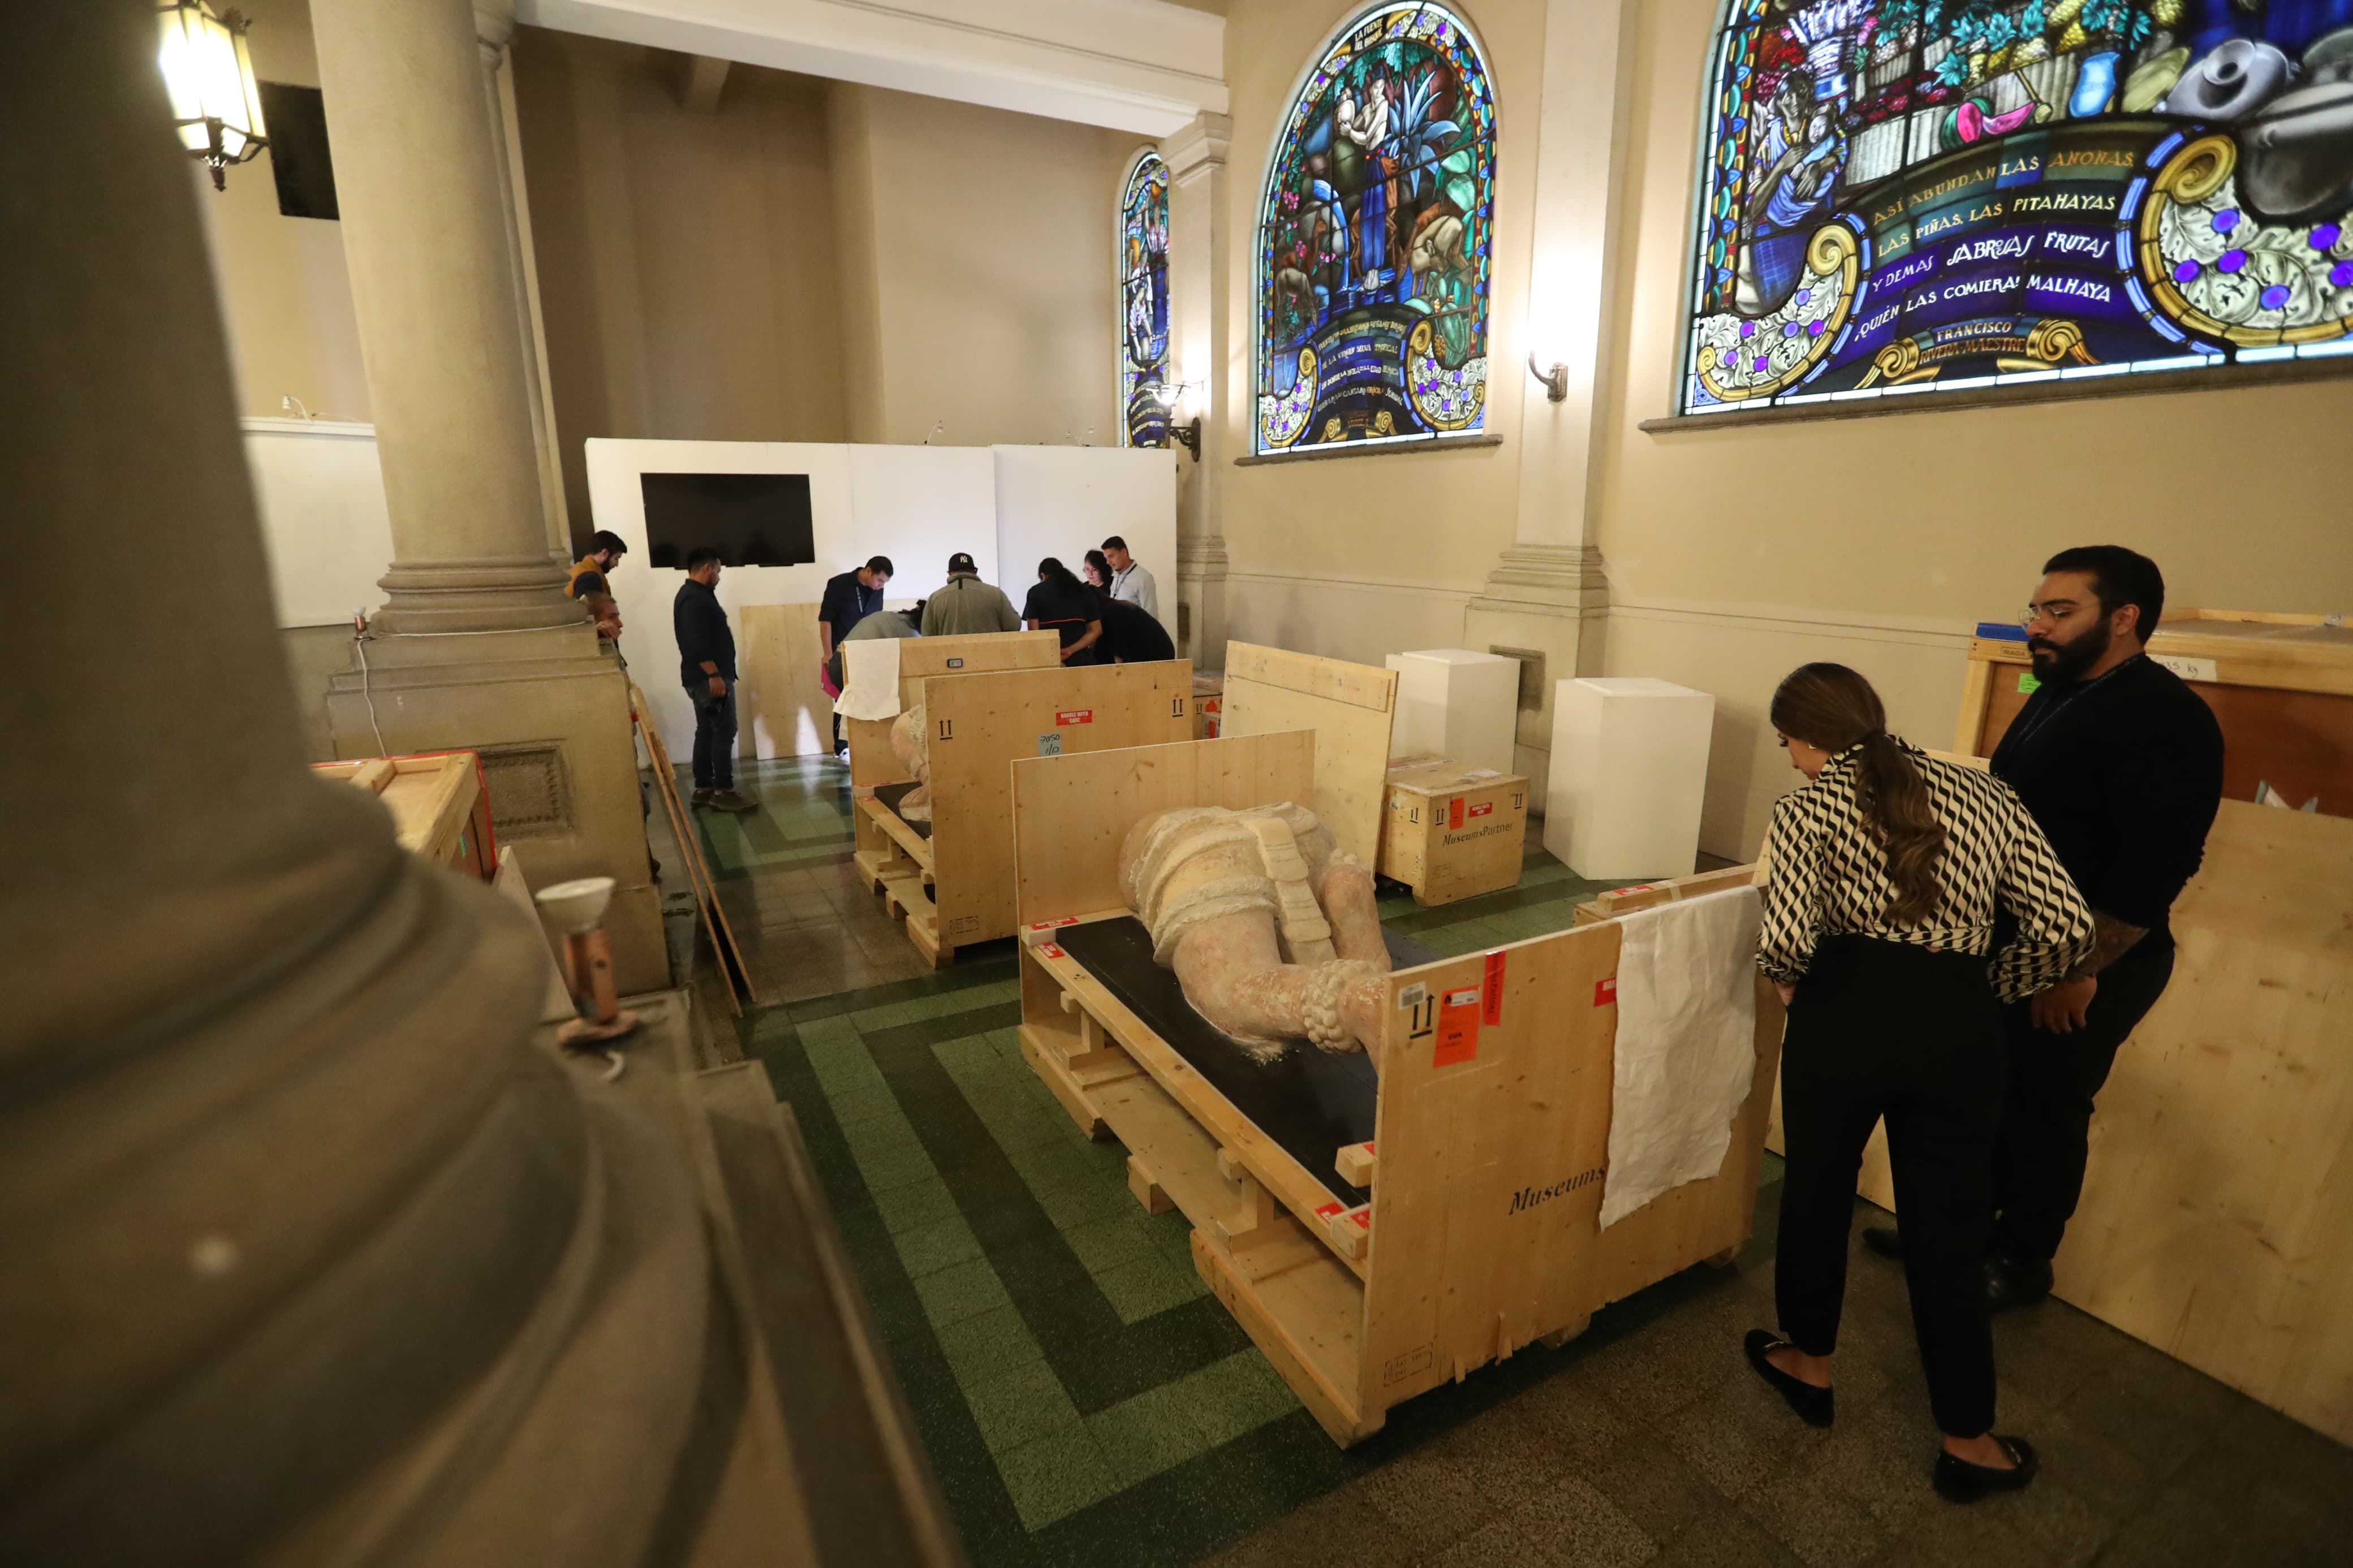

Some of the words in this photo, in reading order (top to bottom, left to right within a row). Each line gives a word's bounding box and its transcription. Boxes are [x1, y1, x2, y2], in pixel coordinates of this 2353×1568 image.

[1355, 30, 1363, 42] LA
[1364, 18, 1384, 36] FUENTE
[1354, 40, 1363, 51] DEL
[1873, 197, 1903, 226] ASÍ
[1909, 166, 1996, 208] ABUNDAN
[2000, 155, 2039, 176] LAS
[1877, 232, 1910, 257] LAS
[1968, 202, 2003, 222] LAS
[2013, 193, 2116, 212] PITAHAYAS
[1872, 278, 1884, 292] Y
[1885, 255, 1934, 287] DEMAS
[2044, 231, 2110, 258] FRUTAS
[1906, 291, 1937, 312] LAS
[1943, 275, 2021, 299] COMIERA!
[2026, 274, 2110, 303] MALHAYA
[1936, 321, 2012, 342] FRANCISCO
[1329, 355, 1337, 365] LA
[1374, 343, 1398, 354] TROPICAL
[2188, 663, 2199, 678] kg
[1442, 822, 1514, 846] MuseumsPartner
[1509, 1167, 1605, 1215] Museums
